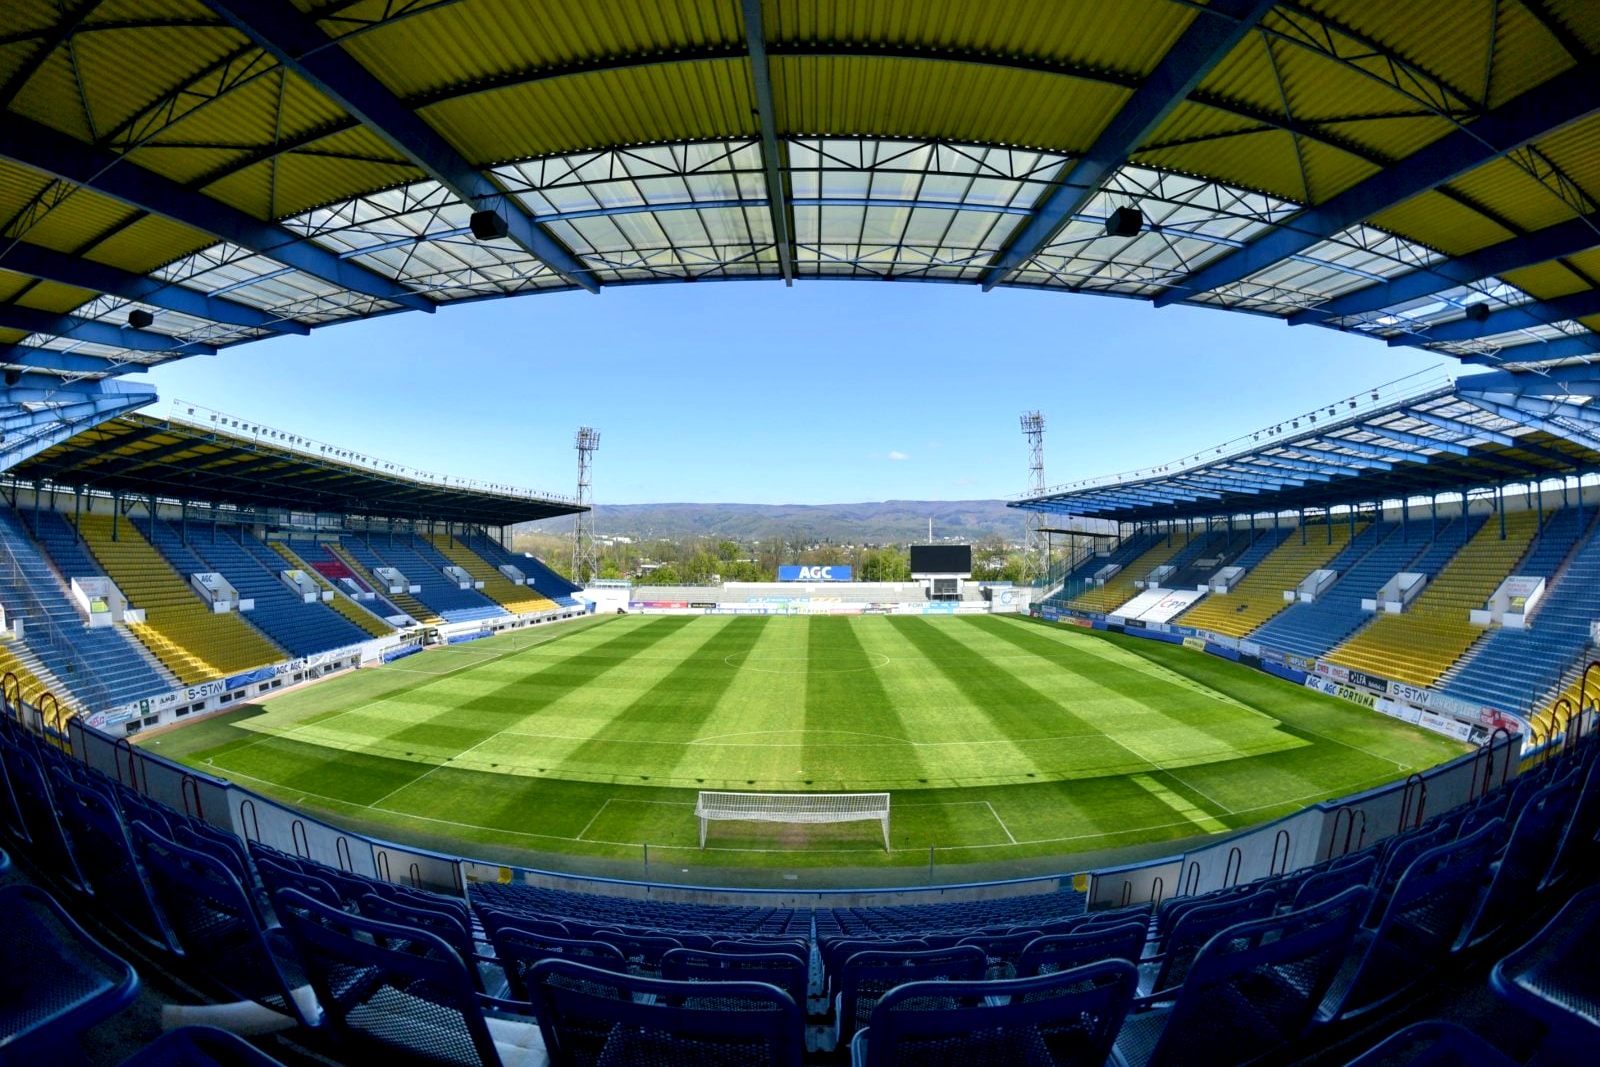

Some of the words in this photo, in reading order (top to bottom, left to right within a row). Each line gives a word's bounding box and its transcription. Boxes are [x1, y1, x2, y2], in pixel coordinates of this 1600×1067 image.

[201, 574, 213, 583] AGC
[799, 566, 832, 579] AGC
[276, 664, 288, 675] AGC
[290, 660, 302, 671] AGC
[188, 681, 224, 700] S-STAV
[1308, 677, 1321, 688] AGC
[1323, 683, 1337, 694] AGC
[1392, 684, 1429, 703] S-STAV
[1338, 687, 1374, 707] FORTUNA
